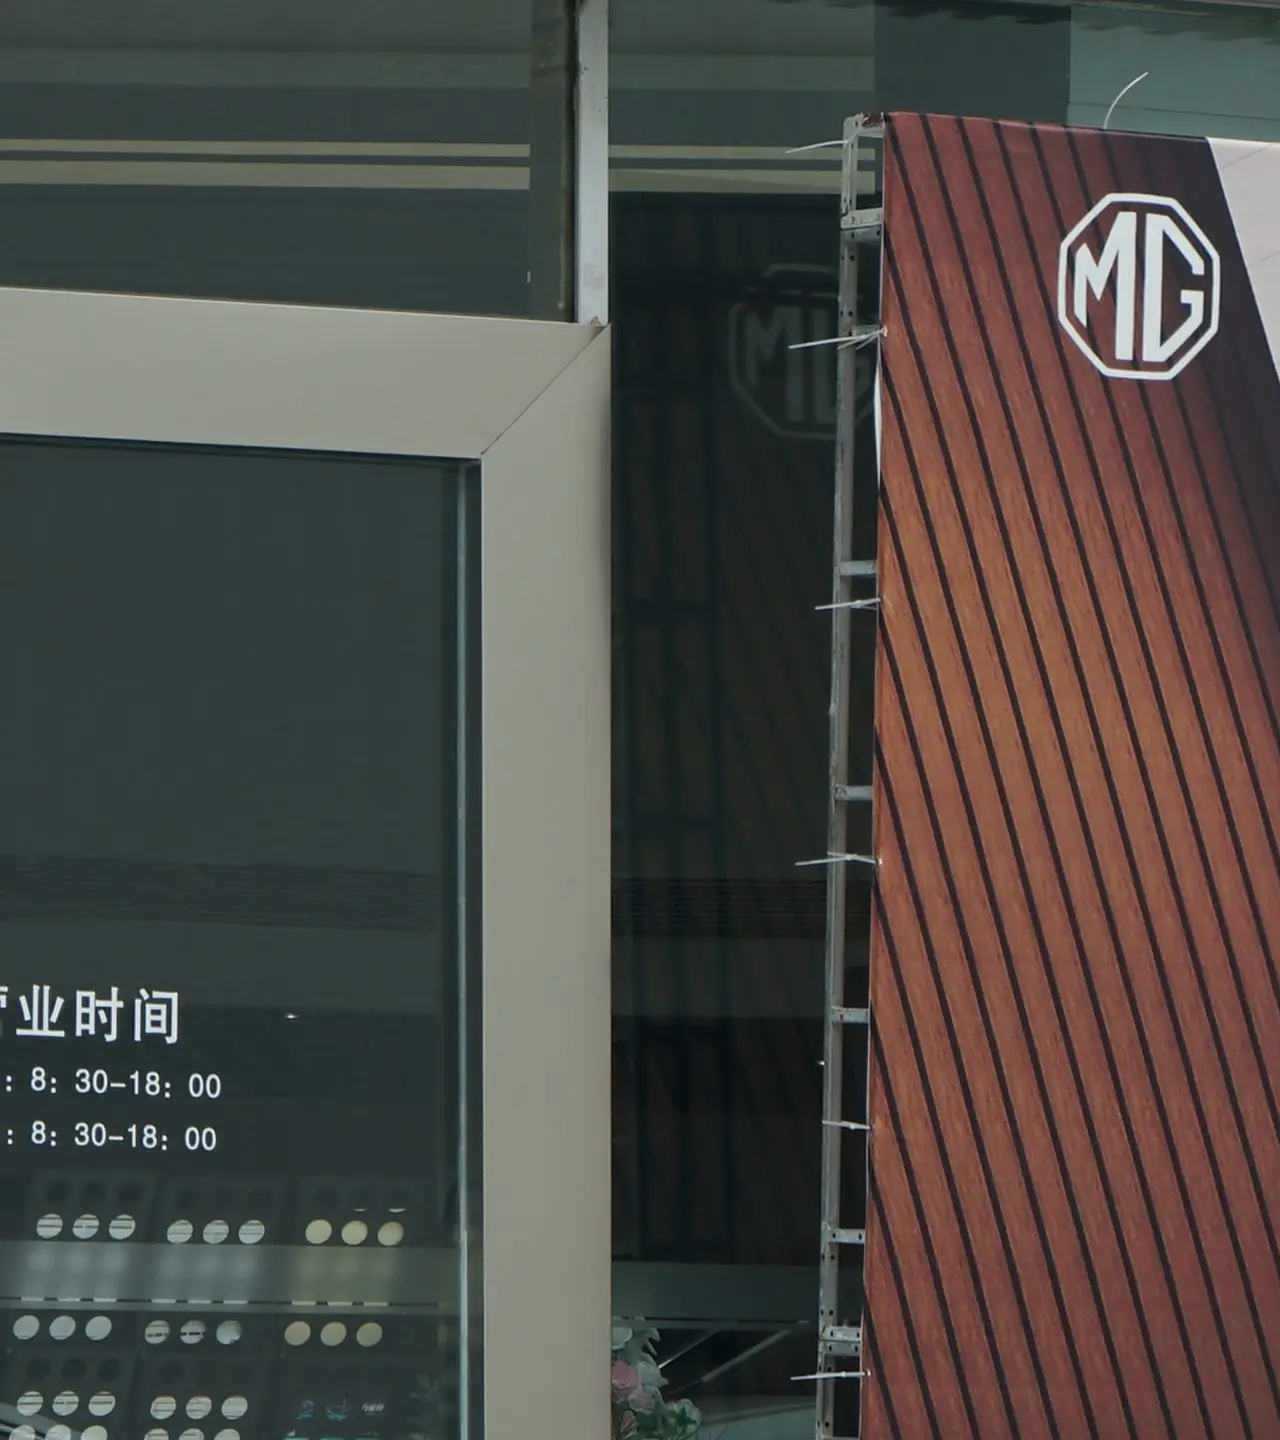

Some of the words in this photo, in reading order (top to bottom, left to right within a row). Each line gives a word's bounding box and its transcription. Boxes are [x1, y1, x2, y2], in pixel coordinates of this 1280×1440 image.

[1072, 209, 1206, 364] MG
[0, 984, 179, 1044] 业时间
